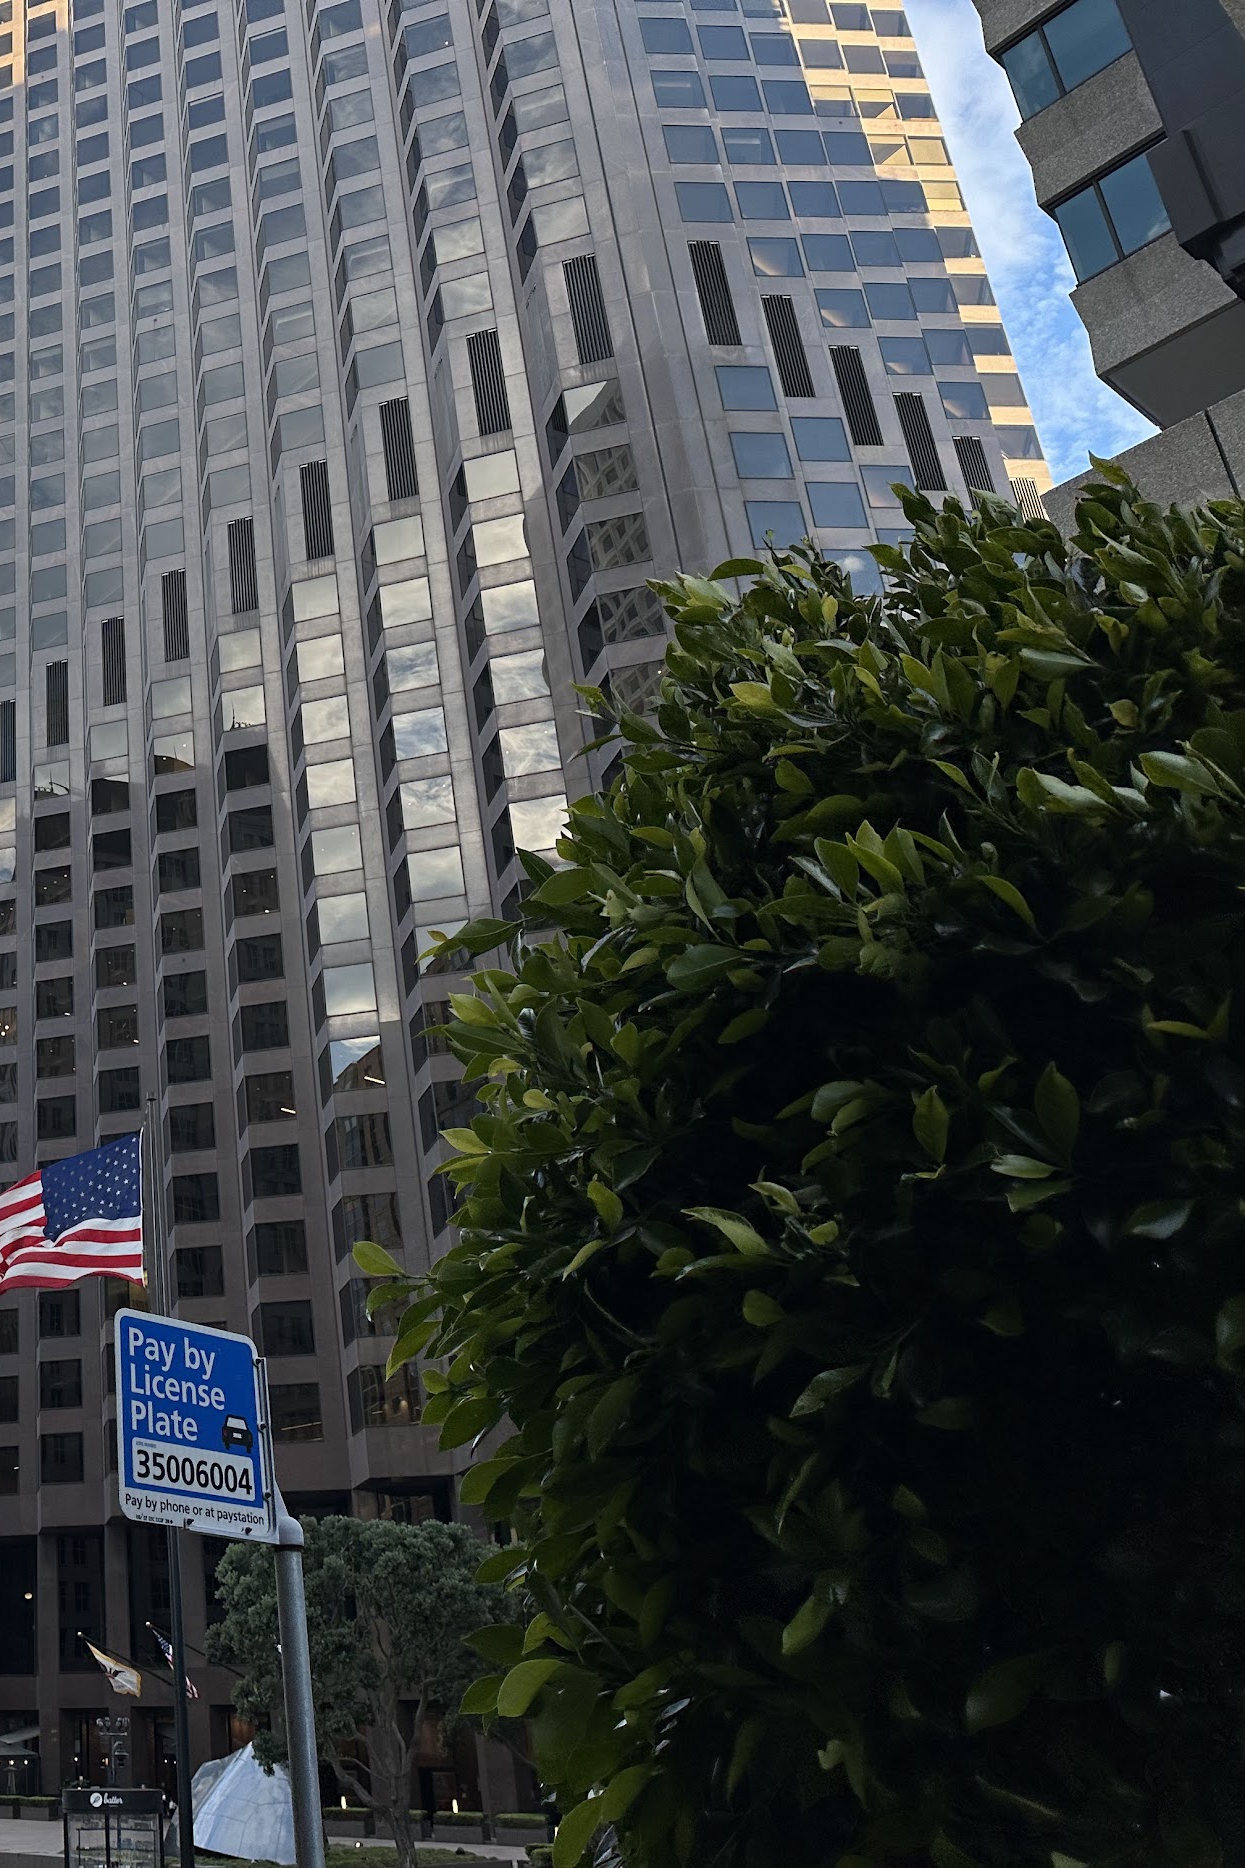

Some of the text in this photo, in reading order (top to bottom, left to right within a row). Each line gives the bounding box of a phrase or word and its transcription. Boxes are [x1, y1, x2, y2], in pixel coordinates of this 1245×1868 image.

[128, 1326, 215, 1380] Pay by
[130, 1362, 226, 1411] License
[131, 1400, 198, 1441] Plate
[137, 1449, 253, 1495] 35006004
[125, 1493, 265, 1525] Pay by phone or at paystation
